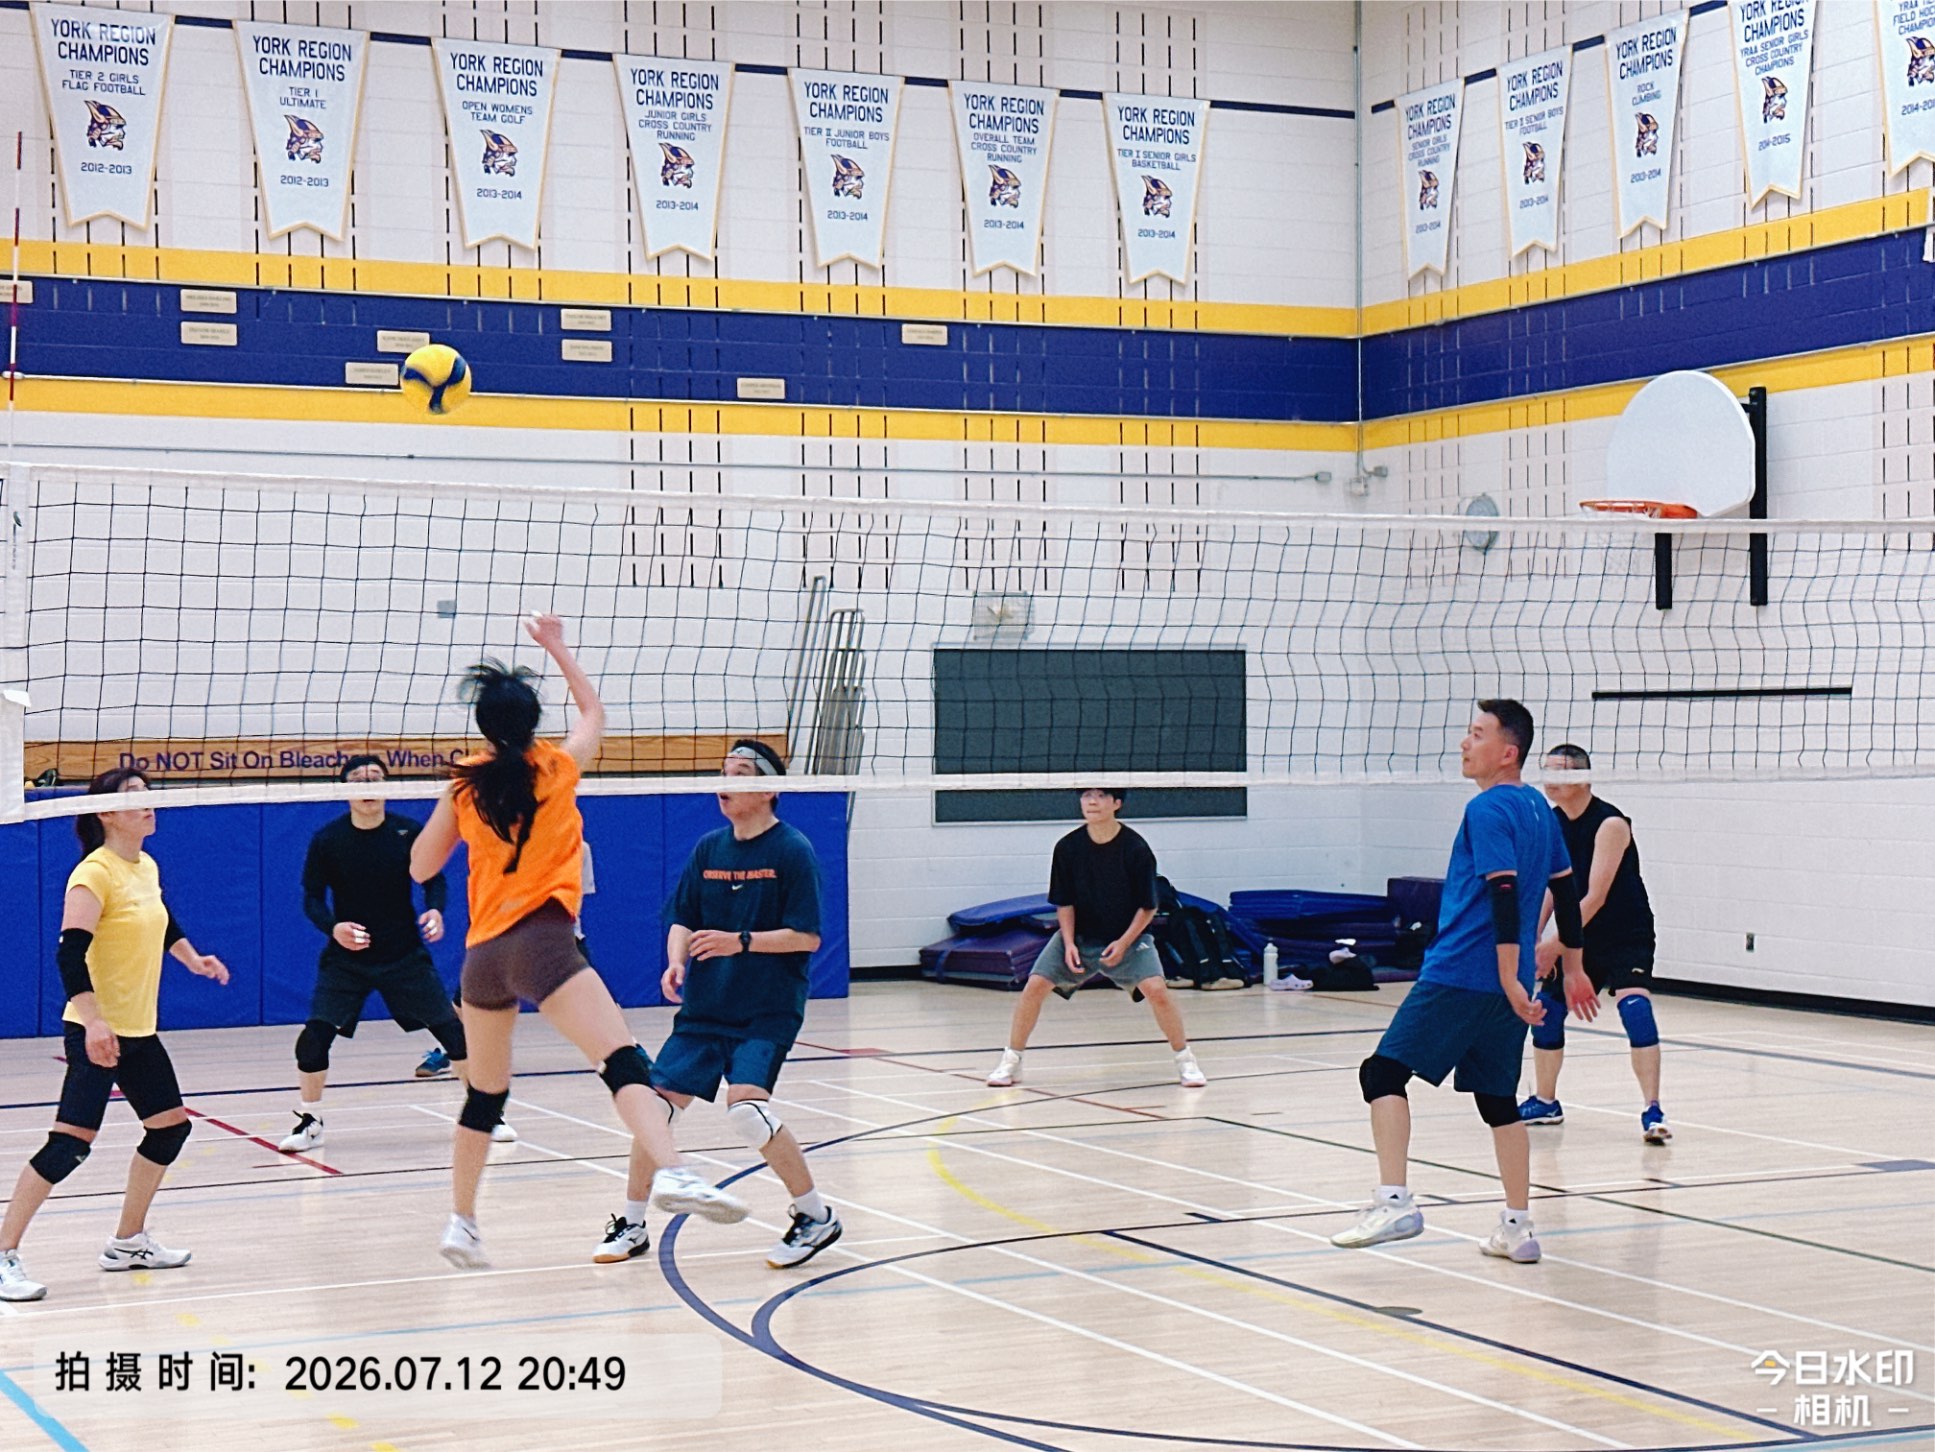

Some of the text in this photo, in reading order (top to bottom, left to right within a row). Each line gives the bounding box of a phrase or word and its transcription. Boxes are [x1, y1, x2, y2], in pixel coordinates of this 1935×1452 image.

[1740, 0, 1766, 23] YORK
[1893, 5, 1935, 26] FIELD HOC
[51, 18, 156, 45] YORK REGION
[1744, 9, 1805, 43] CHAMPIONS
[253, 35, 352, 62] YORK REGION
[1616, 27, 1677, 61] YORK REGION
[1761, 36, 1785, 52] SENIOR
[1788, 29, 1809, 43] GIRLS
[58, 41, 149, 66] CHAMPIONS
[1745, 41, 1803, 68] CROSS COUNTRY
[259, 57, 345, 82] CHAMPIONS
[450, 52, 543, 77] YORK REGION
[1619, 49, 1673, 80] CHAMPIONS
[1755, 56, 1794, 76] CHAMPIONS
[70, 70, 139, 84] TIER 2 GIRLS
[457, 74, 537, 97] CHAMPIONS
[630, 68, 719, 91] YORK REGION
[1507, 60, 1563, 92] YORK REGION
[62, 80, 146, 96] FLAG FOOTBALL
[289, 86, 311, 97] TIER
[804, 81, 889, 104] YORK REGION
[1509, 82, 1559, 112] CHAMPIONS
[1637, 81, 1655, 94] ROCK
[280, 97, 327, 109] ULTIMATE
[462, 101, 533, 115] OPEN WOMENS
[636, 89, 713, 110] CHAMPIONS
[964, 93, 1045, 116] YORK REGION
[1405, 93, 1456, 122] YORK REGION
[1901, 98, 1935, 116] 2014-201
[471, 112, 526, 125] TEAM GOLF
[645, 110, 706, 122] JUNIOR GIRLS
[809, 102, 883, 123] CHAMPIONS
[1118, 106, 1195, 127] YORK REGION
[1505, 119, 1518, 131] TIER
[1548, 106, 1564, 119] BOYS
[638, 119, 712, 132] CROSS COUNTRY
[969, 113, 1039, 134] CHAMPIONS
[1408, 114, 1452, 140] CHAMPIONS
[1519, 122, 1547, 136] FOOTBALL
[657, 130, 695, 141] RUNNING
[804, 126, 822, 136] TIER
[835, 129, 865, 139] JUNIOR
[869, 131, 890, 142] BOYS
[825, 138, 868, 149] FOOTBALL
[973, 132, 1035, 145] OVERALL TEAM
[1123, 125, 1190, 145] CHAMPIONS
[971, 142, 1037, 155] CROSS COUNTRY
[987, 152, 1022, 163] RUNNING
[1117, 148, 1133, 157] TIER
[1143, 150, 1171, 161] SENIOR
[1174, 153, 1196, 163] GIRLS
[81, 162, 132, 174] 2012-2013
[1132, 159, 1181, 171] BASKETBALL
[280, 175, 329, 187] 2012-2013
[477, 188, 522, 200] 2013-2014
[656, 200, 699, 211] 2013-2014
[827, 210, 868, 221] 2013-2014
[984, 219, 1025, 229] 2013-2014
[1138, 228, 1176, 239] 2013-2014
[119, 752, 150, 769] Do
[156, 751, 204, 770] NOT
[210, 751, 237, 769] Sit
[243, 751, 273, 769] On
[280, 750, 350, 768] Bleach
[387, 750, 444, 768] When
